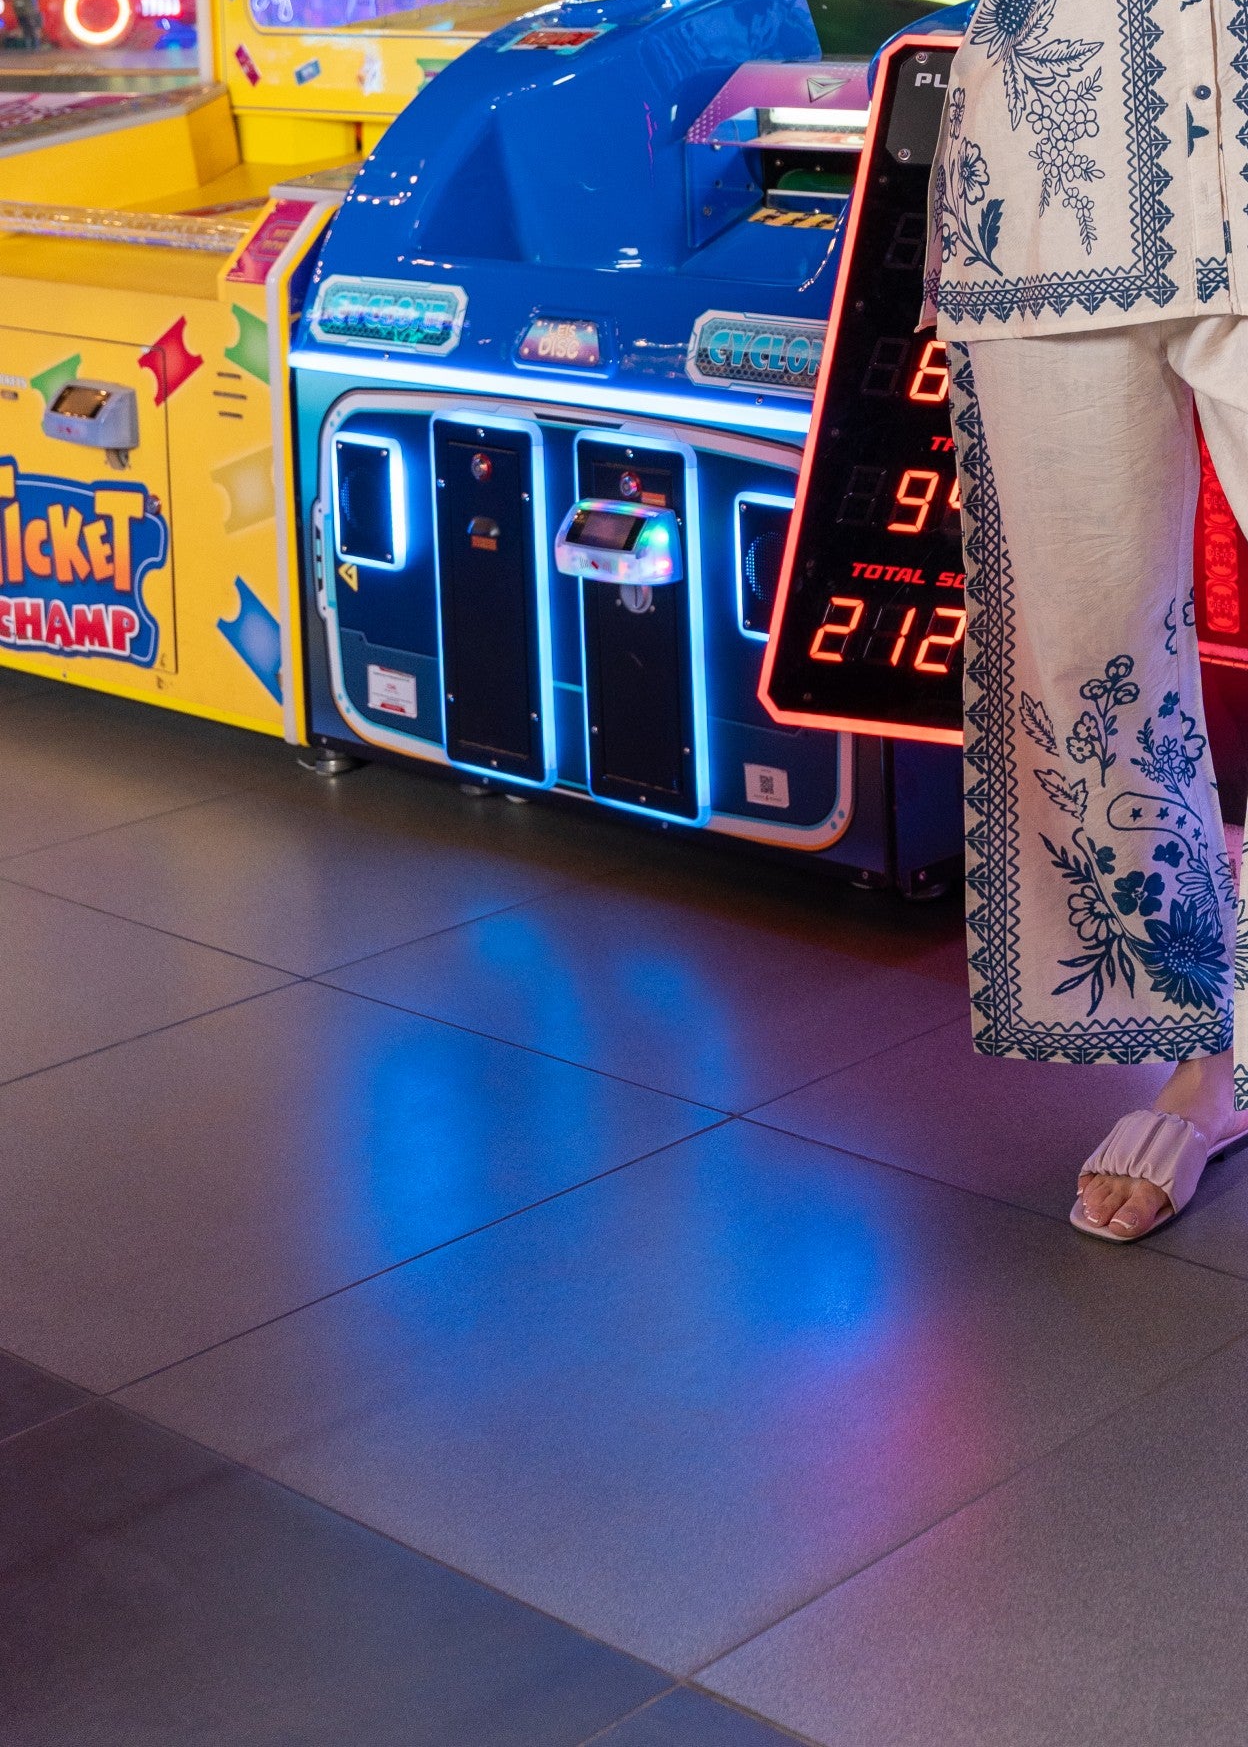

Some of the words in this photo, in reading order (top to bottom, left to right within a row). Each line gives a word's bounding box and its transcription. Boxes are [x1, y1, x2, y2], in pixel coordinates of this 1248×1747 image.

[538, 337, 579, 359] DISC
[708, 329, 825, 375] CYCLON
[852, 562, 926, 584] TOTAL
